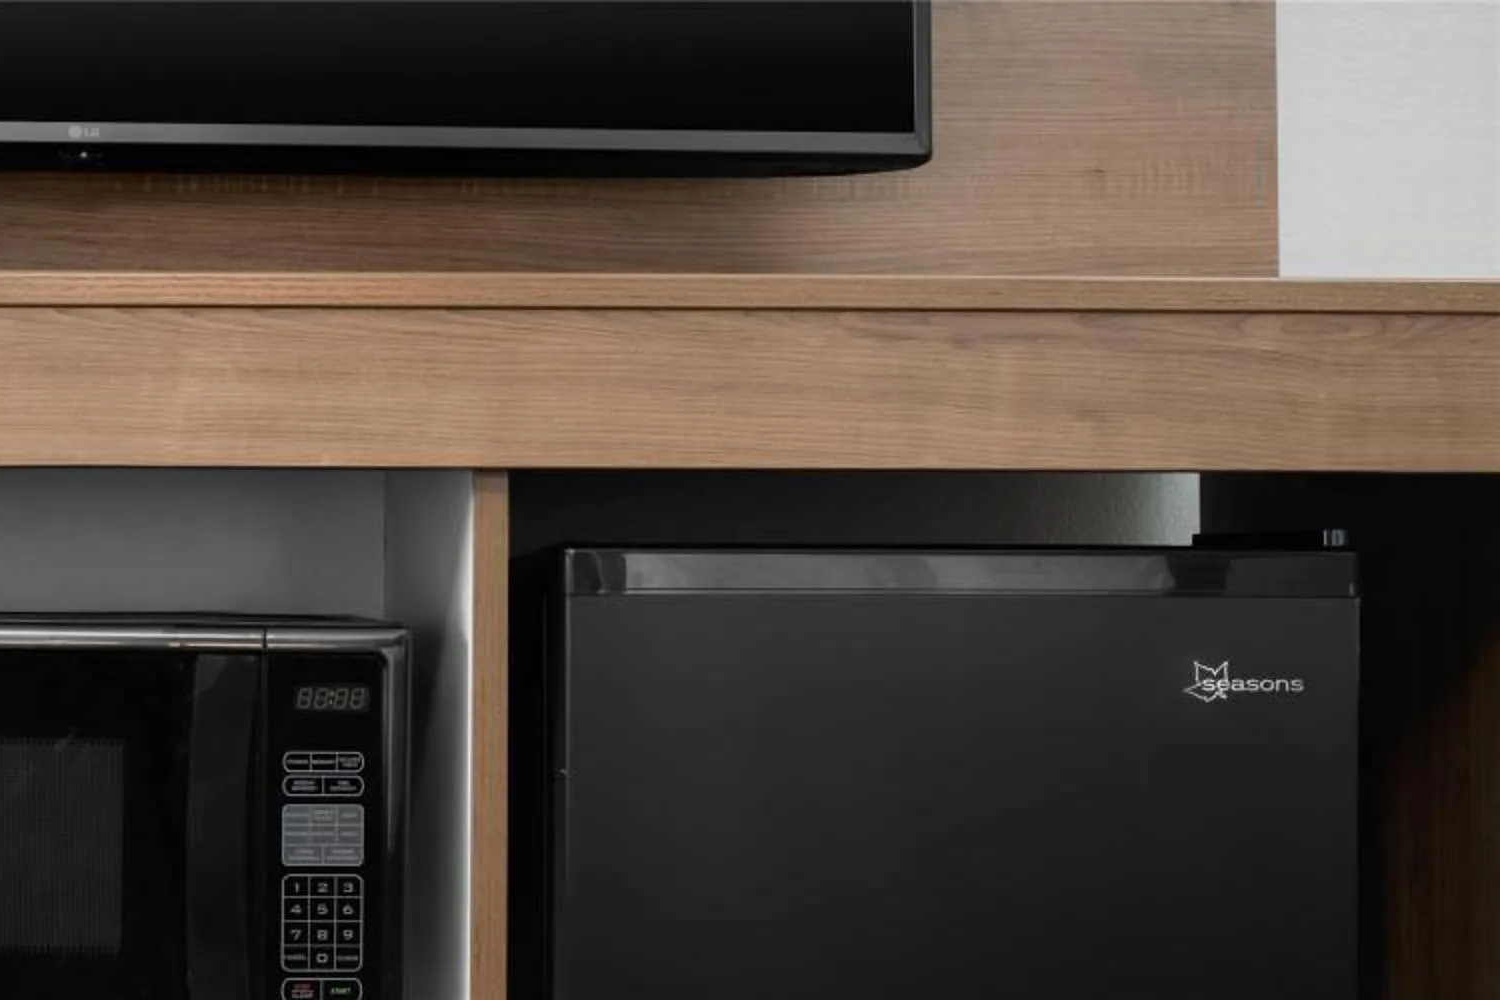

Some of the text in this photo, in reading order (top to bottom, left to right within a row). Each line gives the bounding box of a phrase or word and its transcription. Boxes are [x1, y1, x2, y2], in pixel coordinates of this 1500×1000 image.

[1202, 678, 1304, 692] seasons
[317, 882, 329, 893] 2
[343, 882, 354, 893] 3
[290, 904, 354, 915] 4 5 6
[290, 929, 354, 941] 7 8 9
[316, 952, 329, 964] 0
